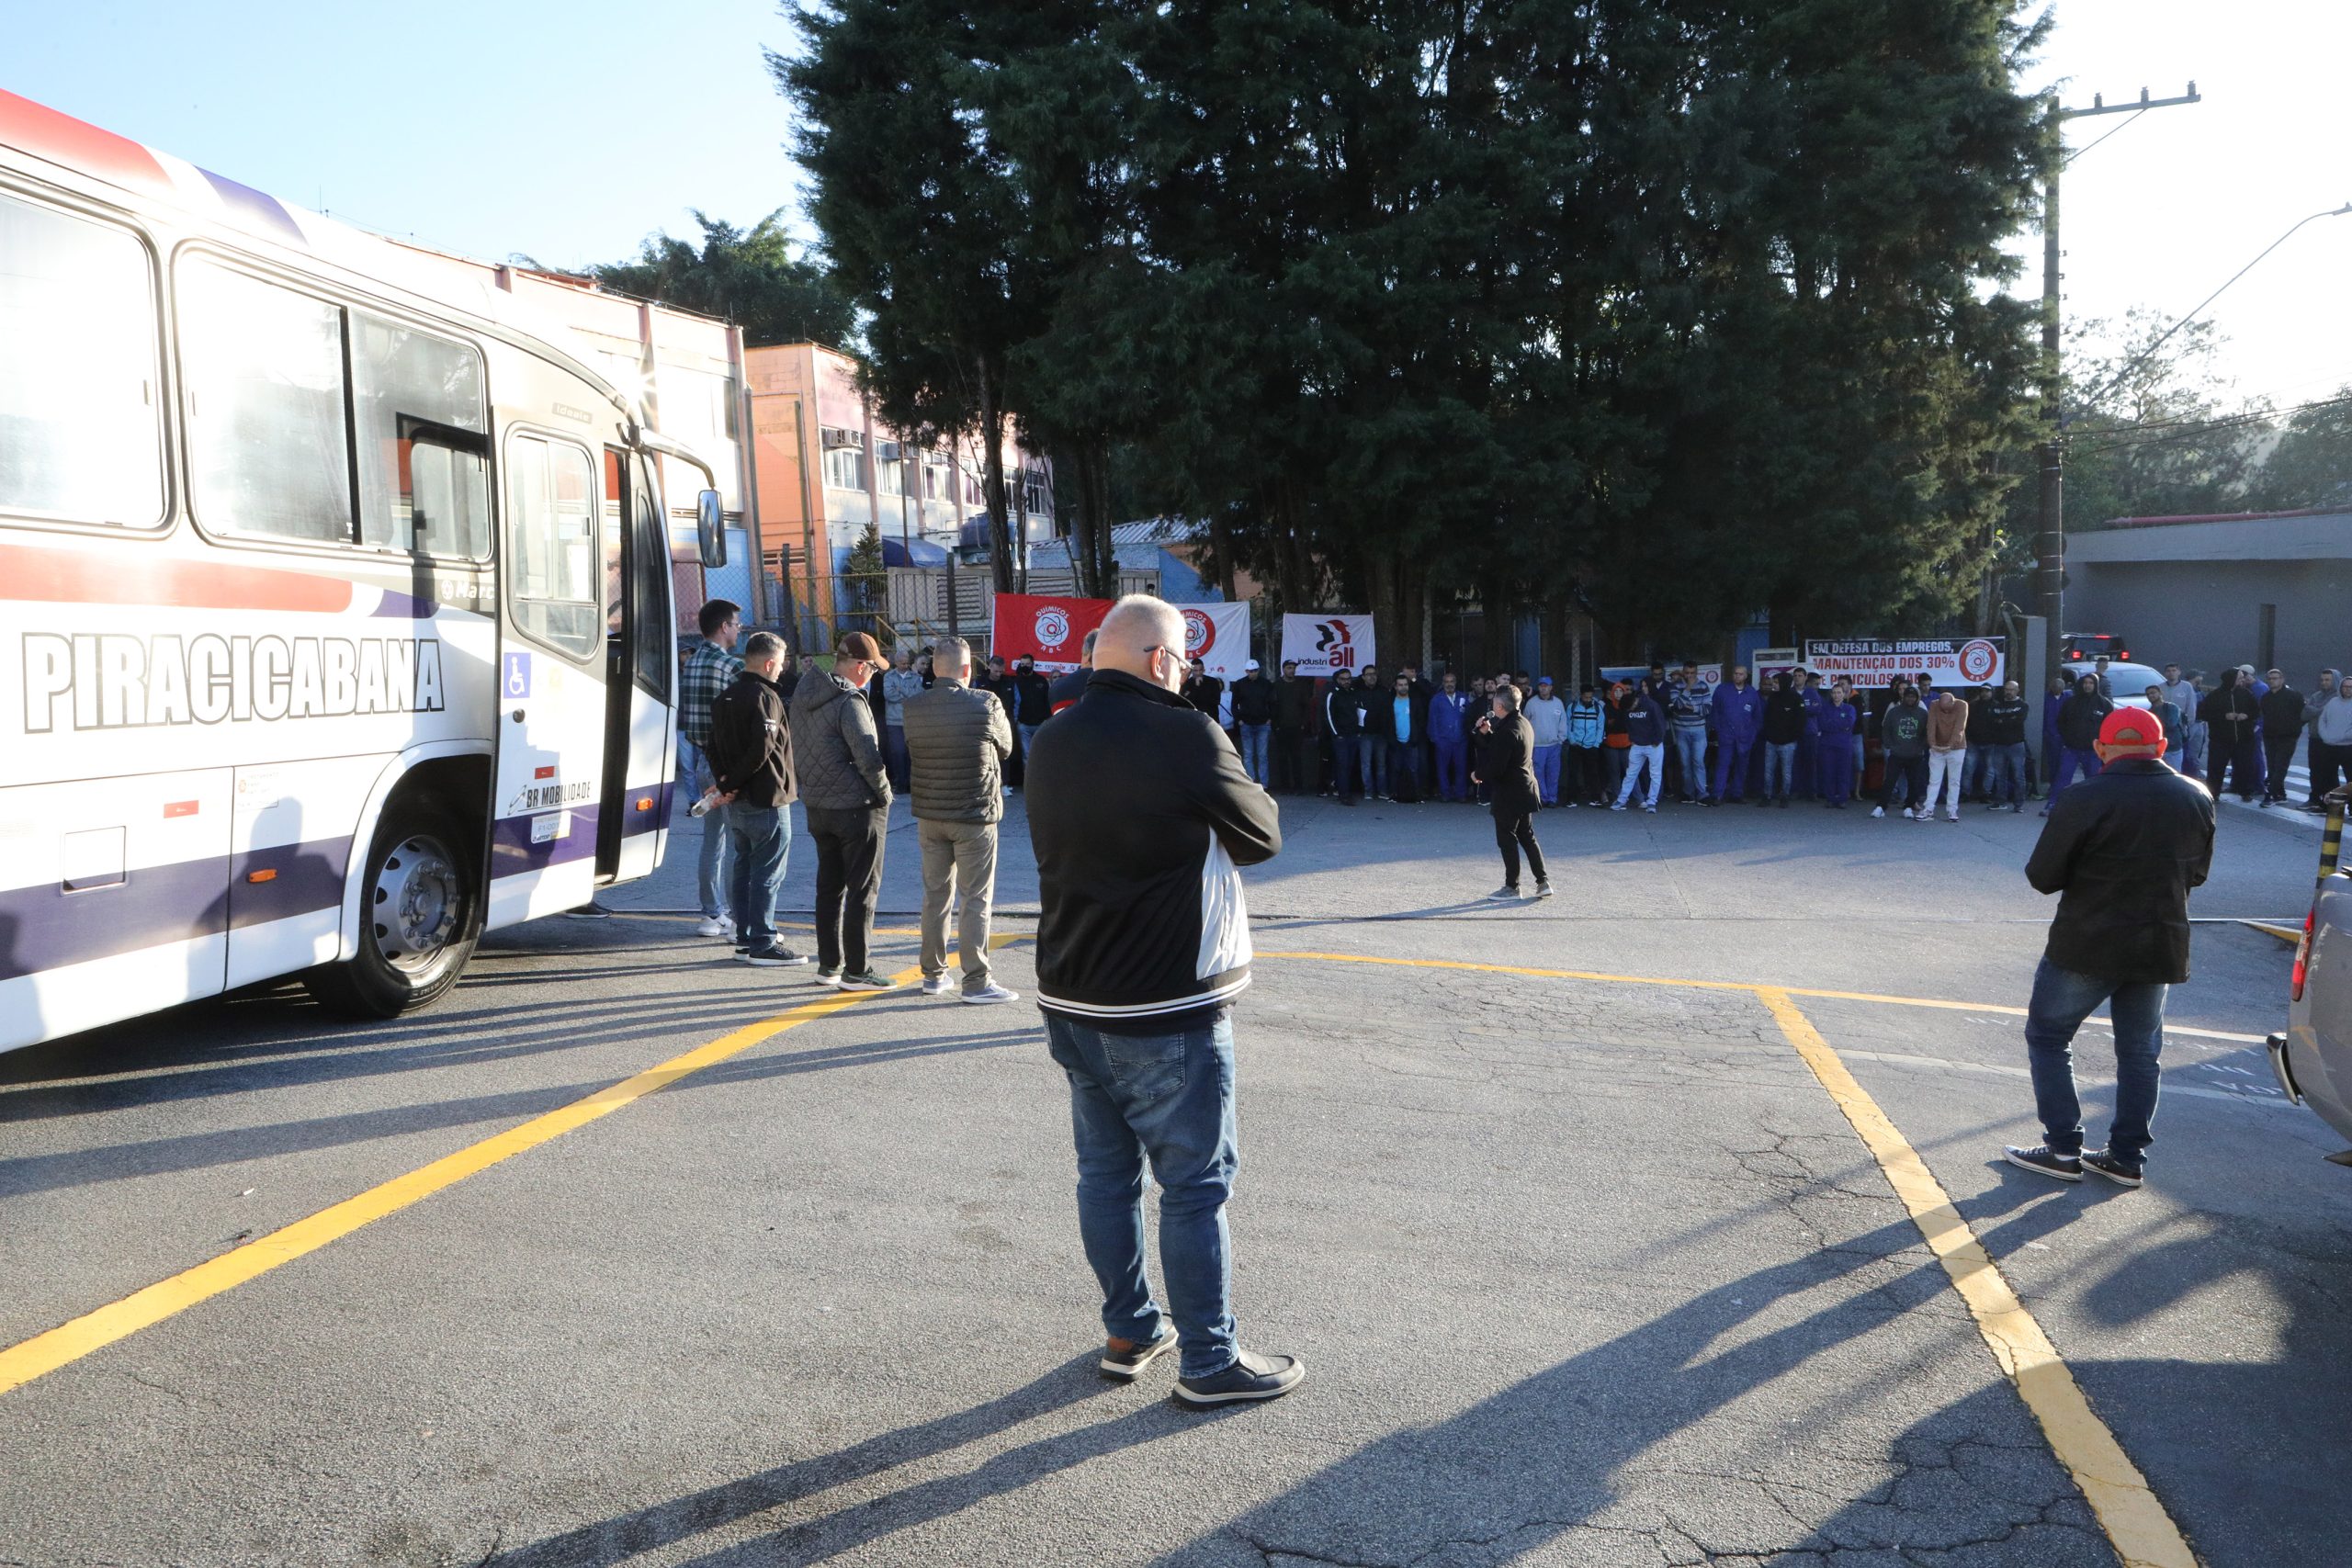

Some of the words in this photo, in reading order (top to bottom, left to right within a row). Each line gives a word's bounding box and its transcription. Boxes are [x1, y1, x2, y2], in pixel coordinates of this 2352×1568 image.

[1036, 605, 1069, 619] QUÍMICOS
[1188, 649, 1201, 659] BC
[1813, 643, 1829, 654] EM
[1832, 642, 1869, 654] DEFESA
[1895, 640, 1954, 654] EMPREGOS,
[1329, 646, 1355, 668] all
[1813, 655, 1895, 673] MANUTENÇÃO
[1899, 657, 1923, 669] DOS
[1927, 655, 1955, 669] 30%
[21, 631, 446, 735] PIRACICABANA
[526, 788, 539, 808] BR
[542, 781, 591, 806] MOBILIDADE
